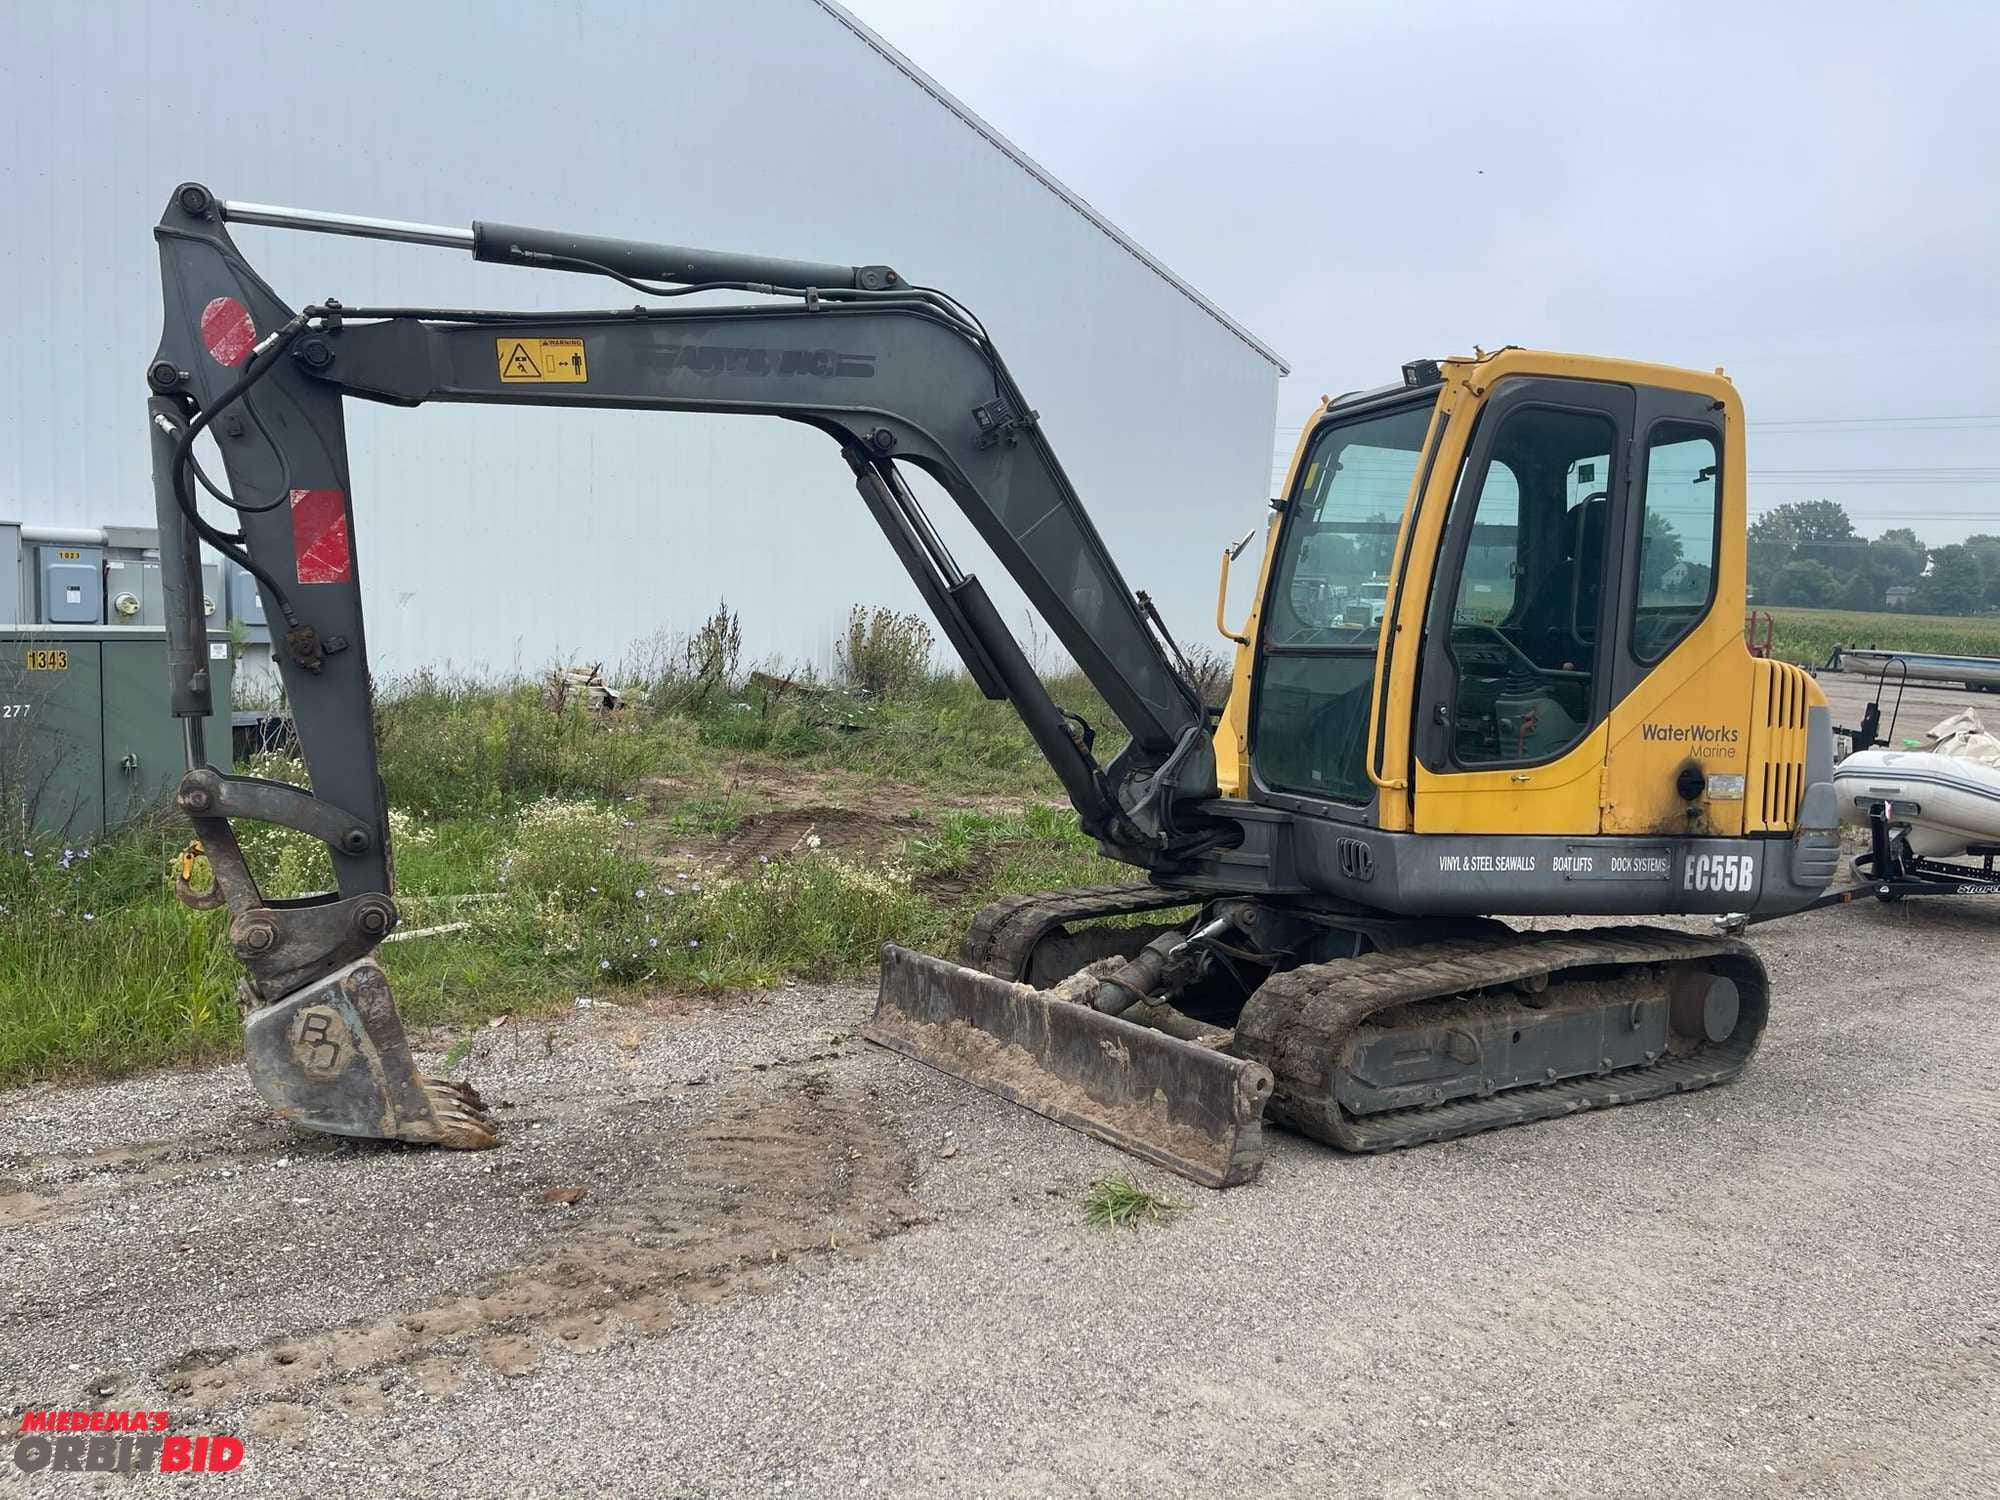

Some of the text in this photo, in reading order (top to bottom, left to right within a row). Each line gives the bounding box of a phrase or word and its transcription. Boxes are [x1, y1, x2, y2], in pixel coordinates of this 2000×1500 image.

[28, 652, 67, 669] 1343
[3, 704, 31, 718] 277
[1642, 724, 1739, 742] WaterWorks
[1689, 744, 1736, 758] Marine
[1439, 856, 1535, 871] VINYL & STEEL SEAWALLS
[1552, 856, 1593, 872] BOAT LIFTS
[1611, 857, 1668, 872] DOCK SYSTEMS
[1684, 854, 1753, 892] EC55B
[1957, 884, 2000, 894] Shore
